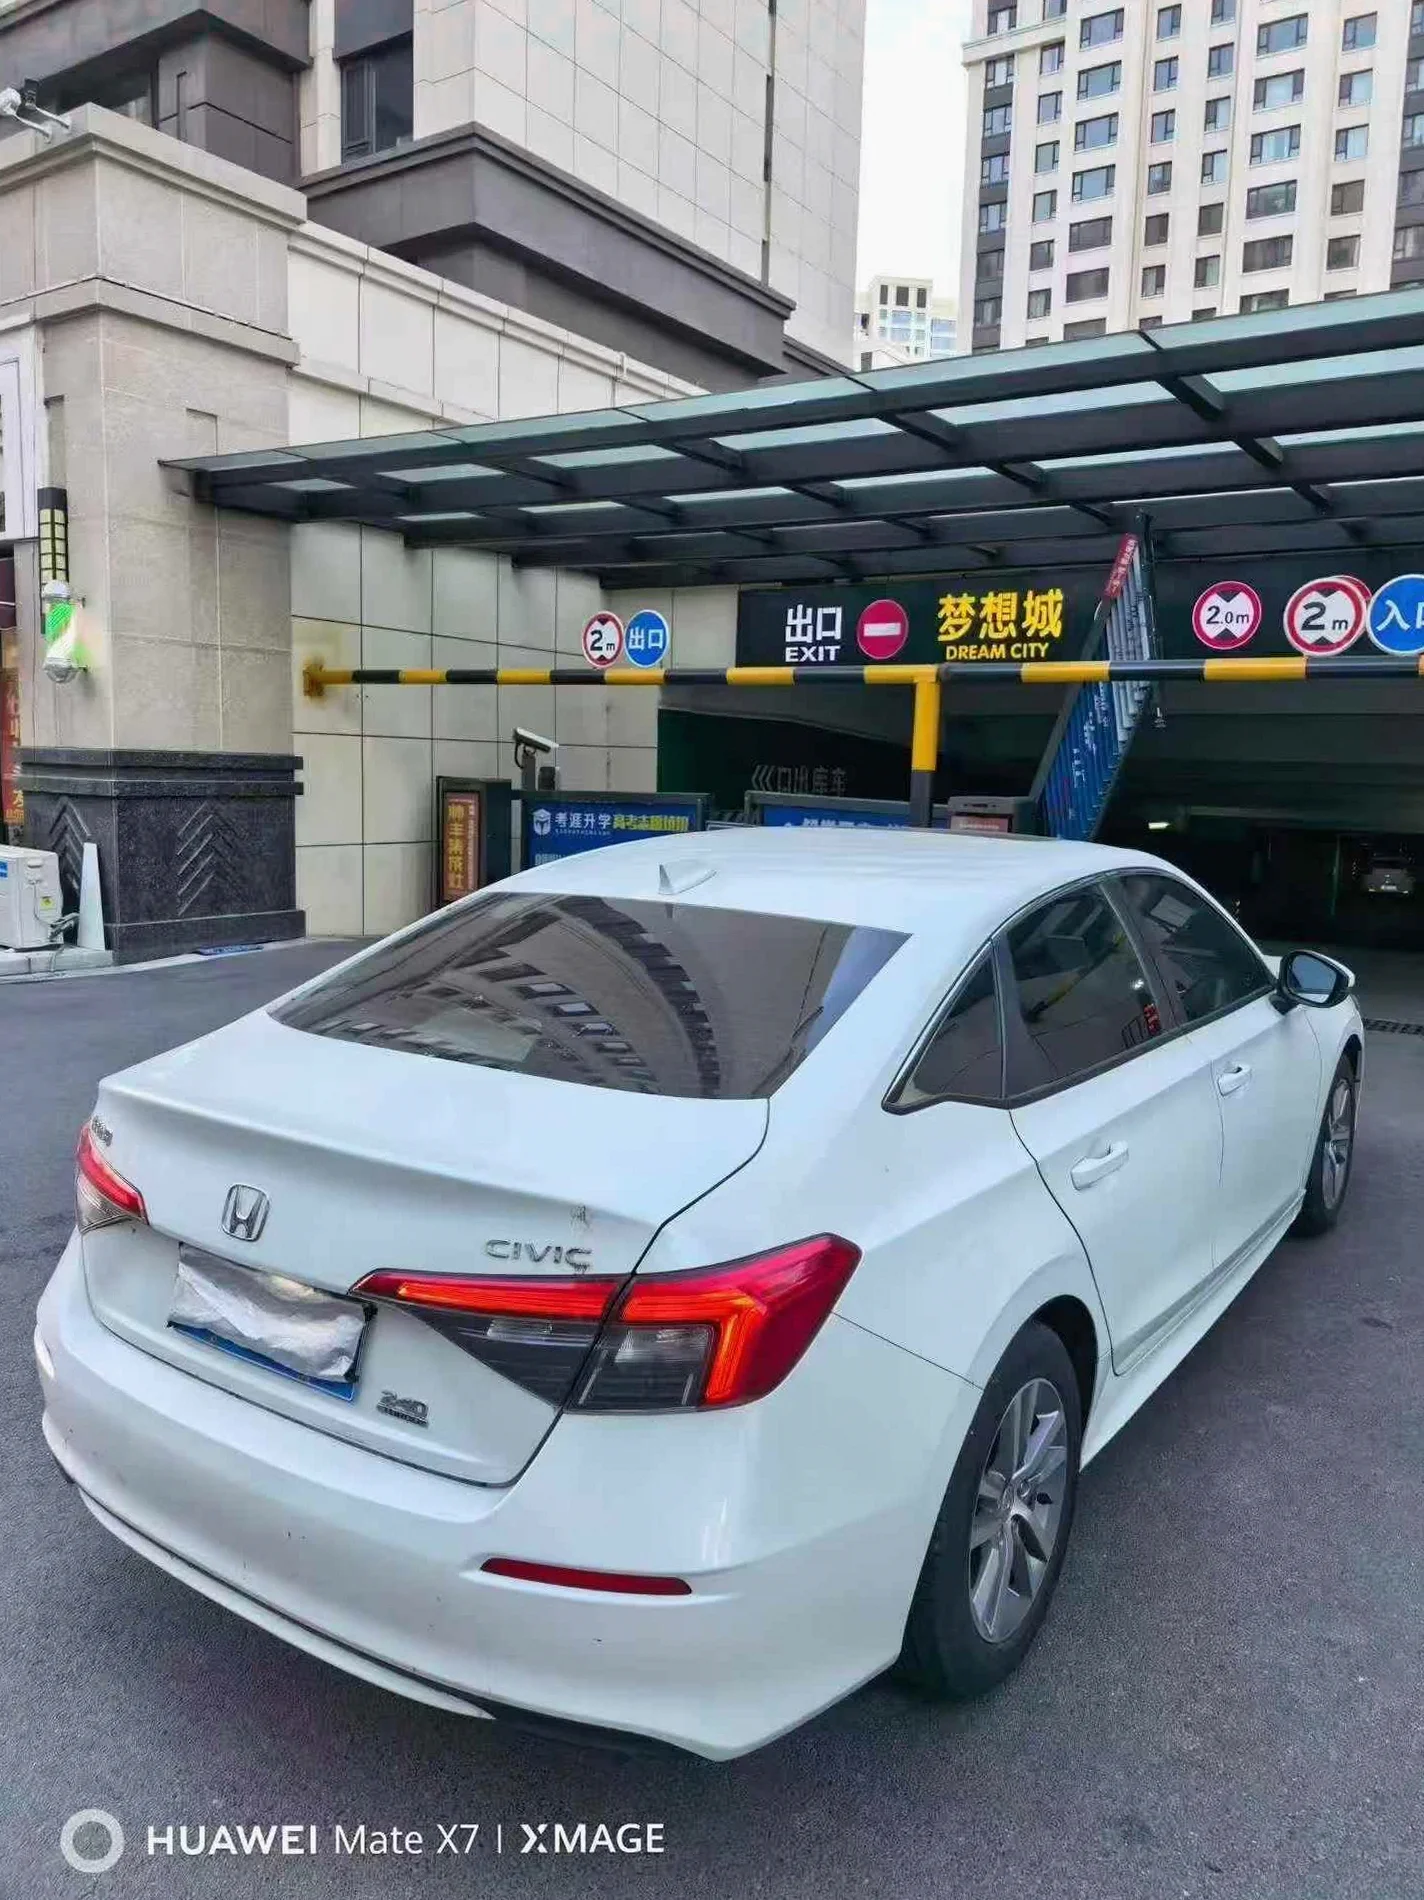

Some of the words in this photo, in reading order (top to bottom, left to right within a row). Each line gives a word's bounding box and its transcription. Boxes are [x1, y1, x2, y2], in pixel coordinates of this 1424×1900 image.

[784, 604, 842, 643] 出口
[937, 588, 1064, 641] 梦想城
[1206, 605, 1250, 625] 2.0m
[1301, 601, 1349, 631] 2m
[1376, 599, 1424, 632] 入
[590, 629, 616, 652] 2m
[628, 627, 664, 650] 出口
[945, 644, 1007, 660] DREAM
[1010, 642, 1049, 658] CITY
[785, 645, 841, 662] EXIT
[485, 1239, 593, 1272] CIVIC
